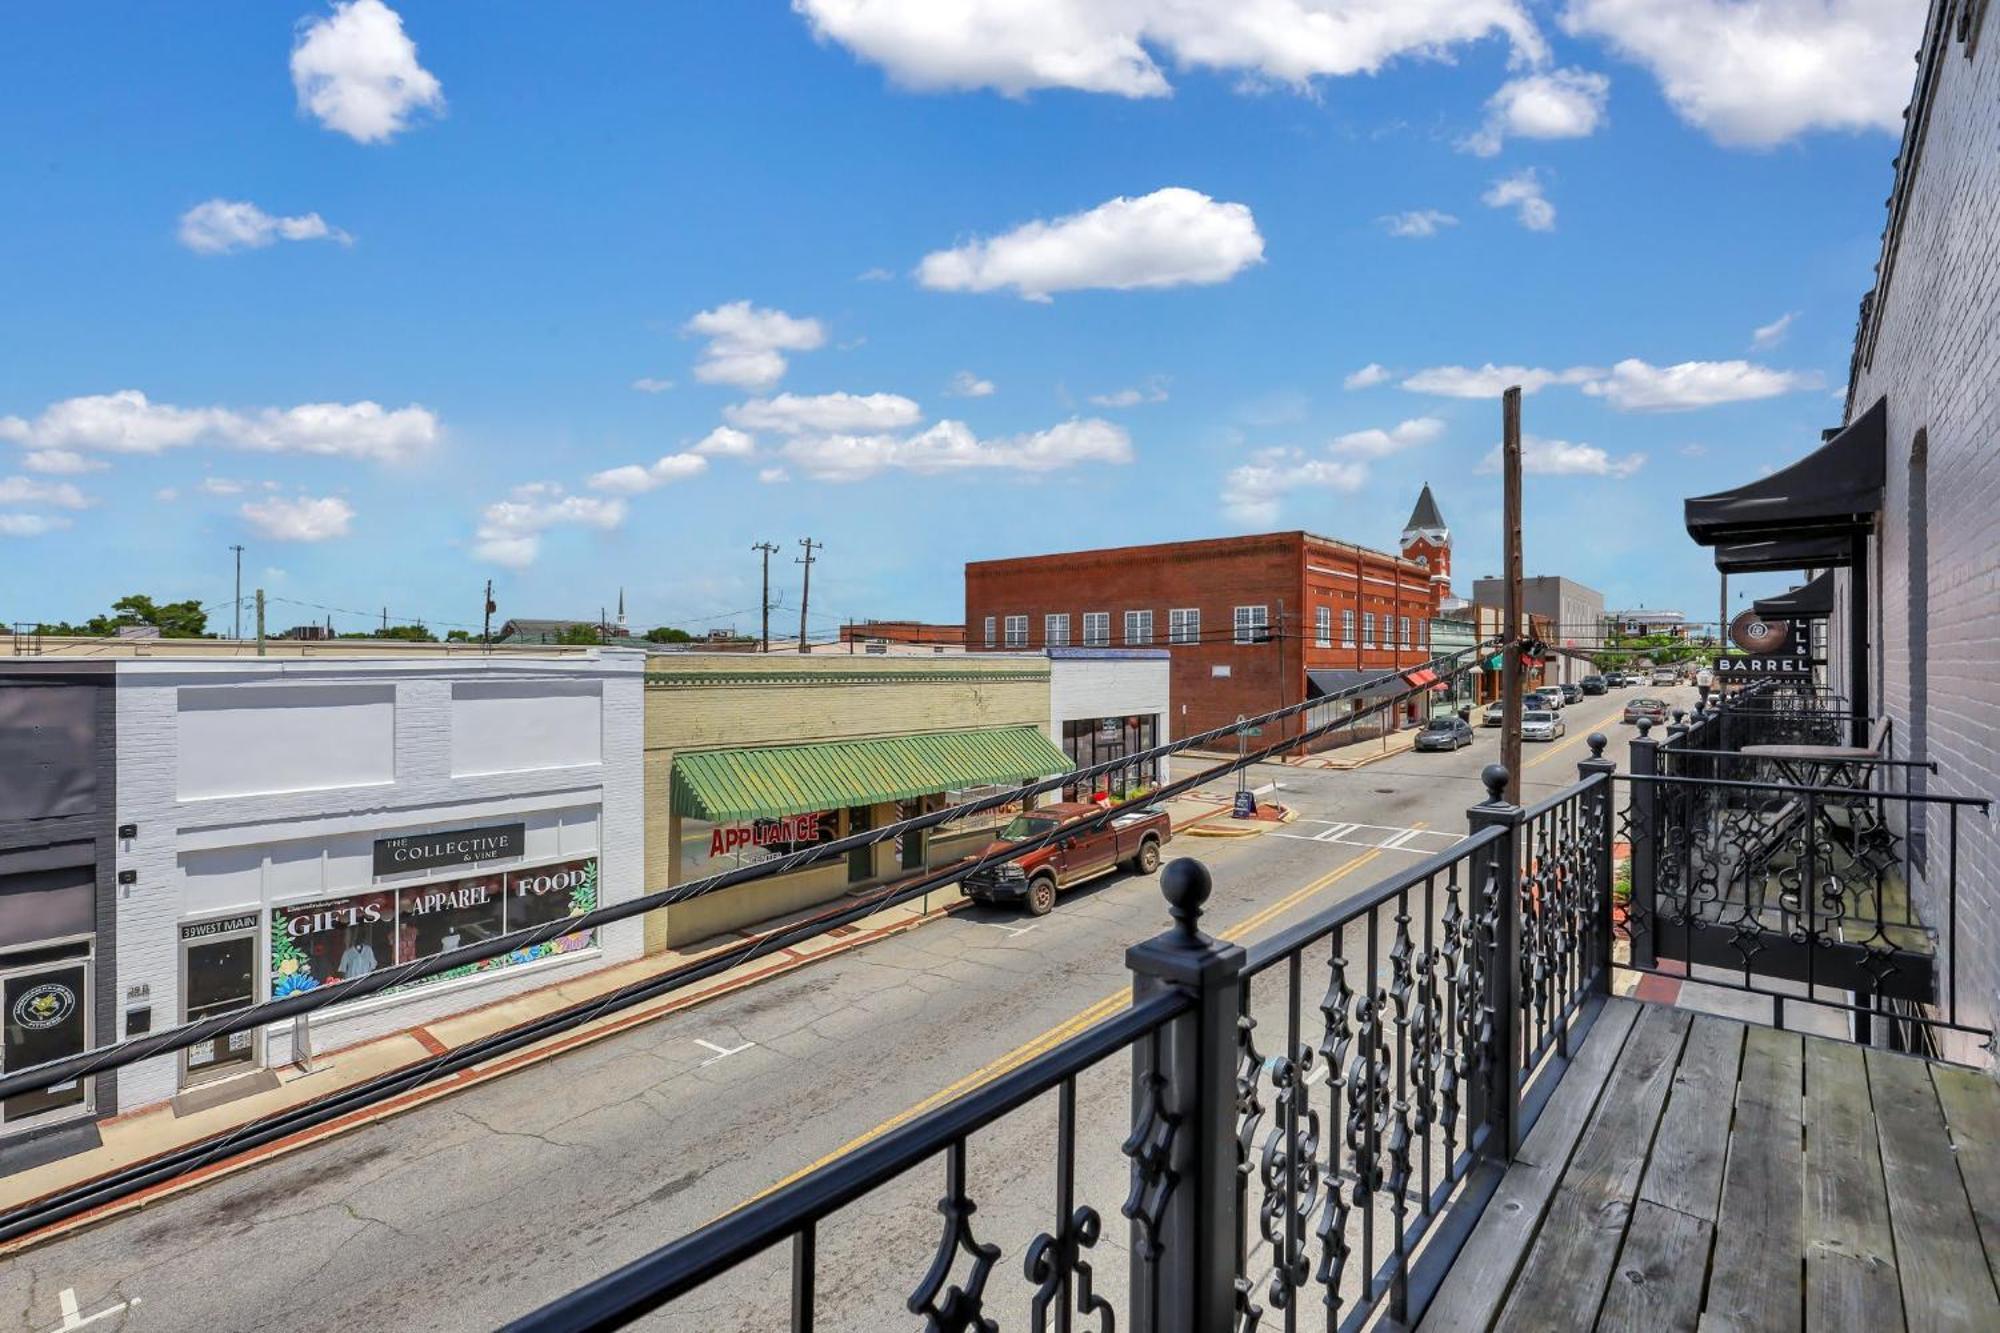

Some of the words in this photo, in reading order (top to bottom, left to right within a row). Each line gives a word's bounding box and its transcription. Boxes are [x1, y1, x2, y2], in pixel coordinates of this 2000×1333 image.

[1719, 660, 1809, 671] BARREL
[386, 838, 409, 848] THE
[394, 835, 509, 862] COLLECTIVE
[709, 812, 819, 858] APPLIANCE
[463, 853, 472, 861] &
[475, 850, 498, 860] VINE
[519, 870, 586, 897] FOOD
[412, 886, 490, 916] APPAREL
[223, 916, 256, 930] MAIN
[287, 903, 381, 937] GIFTS
